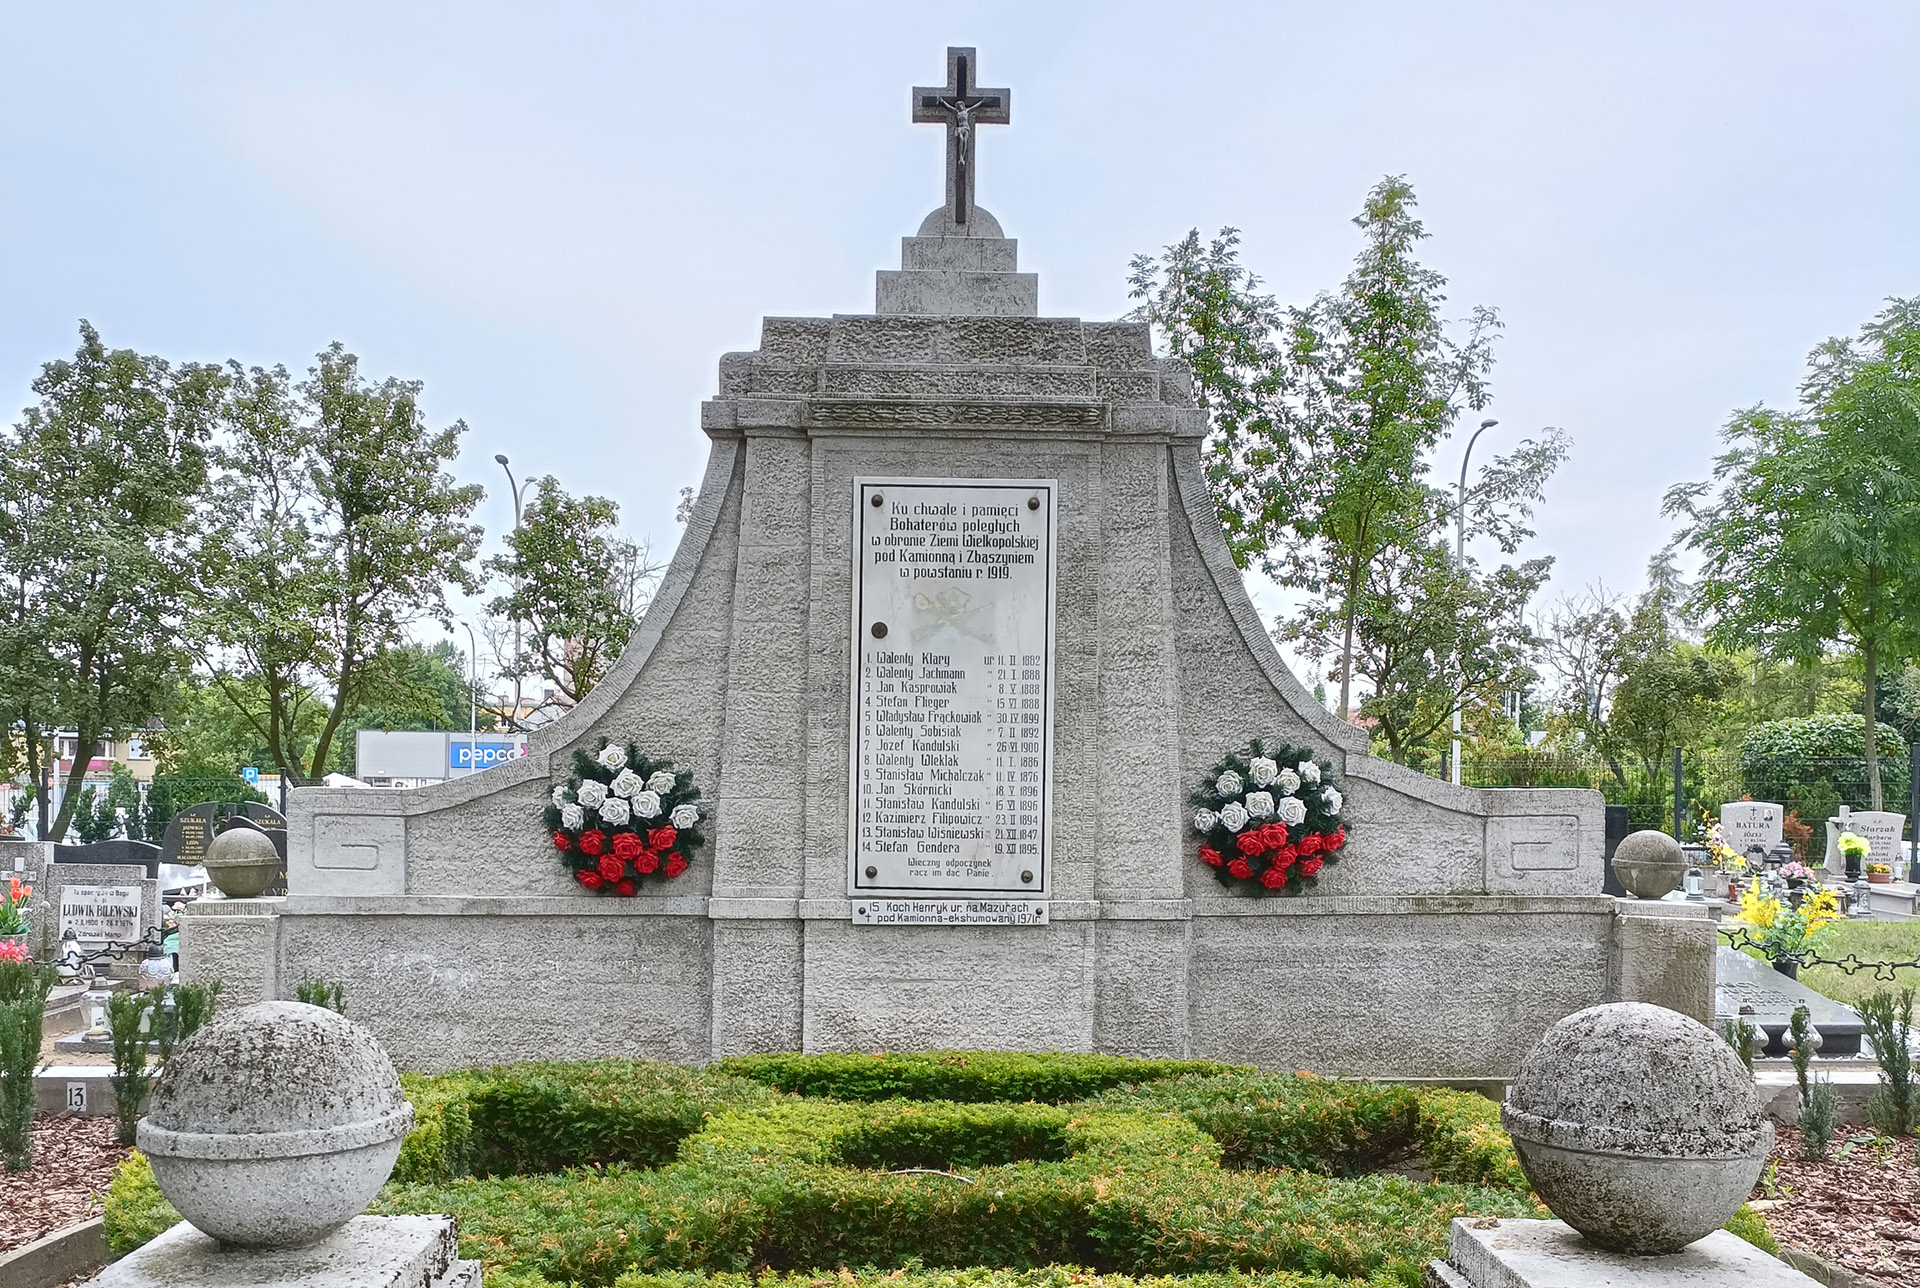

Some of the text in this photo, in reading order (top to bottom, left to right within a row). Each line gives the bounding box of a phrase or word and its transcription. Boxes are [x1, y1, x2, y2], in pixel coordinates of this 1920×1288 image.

[892, 502, 1019, 519] Ku chwale i pamięci
[890, 517, 1020, 534] Bohaterów poległych
[871, 534, 1039, 551] w obronie Ziemi Wielkopolskiej
[874, 549, 1034, 566] pod Kamionną i Zbąszyniem
[900, 567, 909, 577] w
[913, 566, 972, 580] powstaniu
[876, 652, 913, 666] Walenty
[922, 652, 950, 667] Klary
[1022, 656, 1040, 666] 1882
[876, 666, 913, 681] Walenty
[919, 668, 965, 679] Jachmann
[1022, 670, 1040, 681] 1888
[876, 681, 894, 693] Jan
[901, 682, 957, 694] Kasprowiak
[1022, 684, 1040, 695] 1888
[876, 696, 908, 707] Stefan
[915, 696, 950, 710] Flieger
[876, 710, 924, 724] Władysław
[928, 711, 982, 724] Frąckowiak
[876, 725, 913, 740] Walenty
[921, 726, 962, 737] Sobisiak
[1021, 728, 1039, 738] 1892
[912, 740, 960, 752] Kandulski
[876, 754, 914, 768] Walenty
[921, 755, 959, 766] Wleklak
[1020, 757, 1039, 767] 1886
[876, 769, 924, 781] Stanisław
[930, 769, 984, 782] Michalczak
[1020, 772, 1038, 782] 1876
[876, 783, 895, 795] Jan
[1020, 786, 1038, 796] 1896
[876, 797, 924, 810] Stanisław
[932, 798, 980, 810] Kandulski
[1020, 800, 1038, 811] 1896
[876, 812, 926, 824] Kazimierz
[933, 813, 982, 825] Filipowicz
[1020, 815, 1038, 825] 1894
[875, 826, 924, 838] Stanisław
[875, 841, 908, 852] Stefan
[917, 842, 960, 853] Gendera
[908, 858, 992, 868] Wieczny odpoczynek
[946, 868, 960, 877] dać
[64, 904, 138, 918] LUDWIK BILEWSKI
[886, 903, 910, 912] Koch
[913, 903, 948, 914] Henryk
[951, 904, 963, 913] ur.
[877, 914, 895, 923] pod
